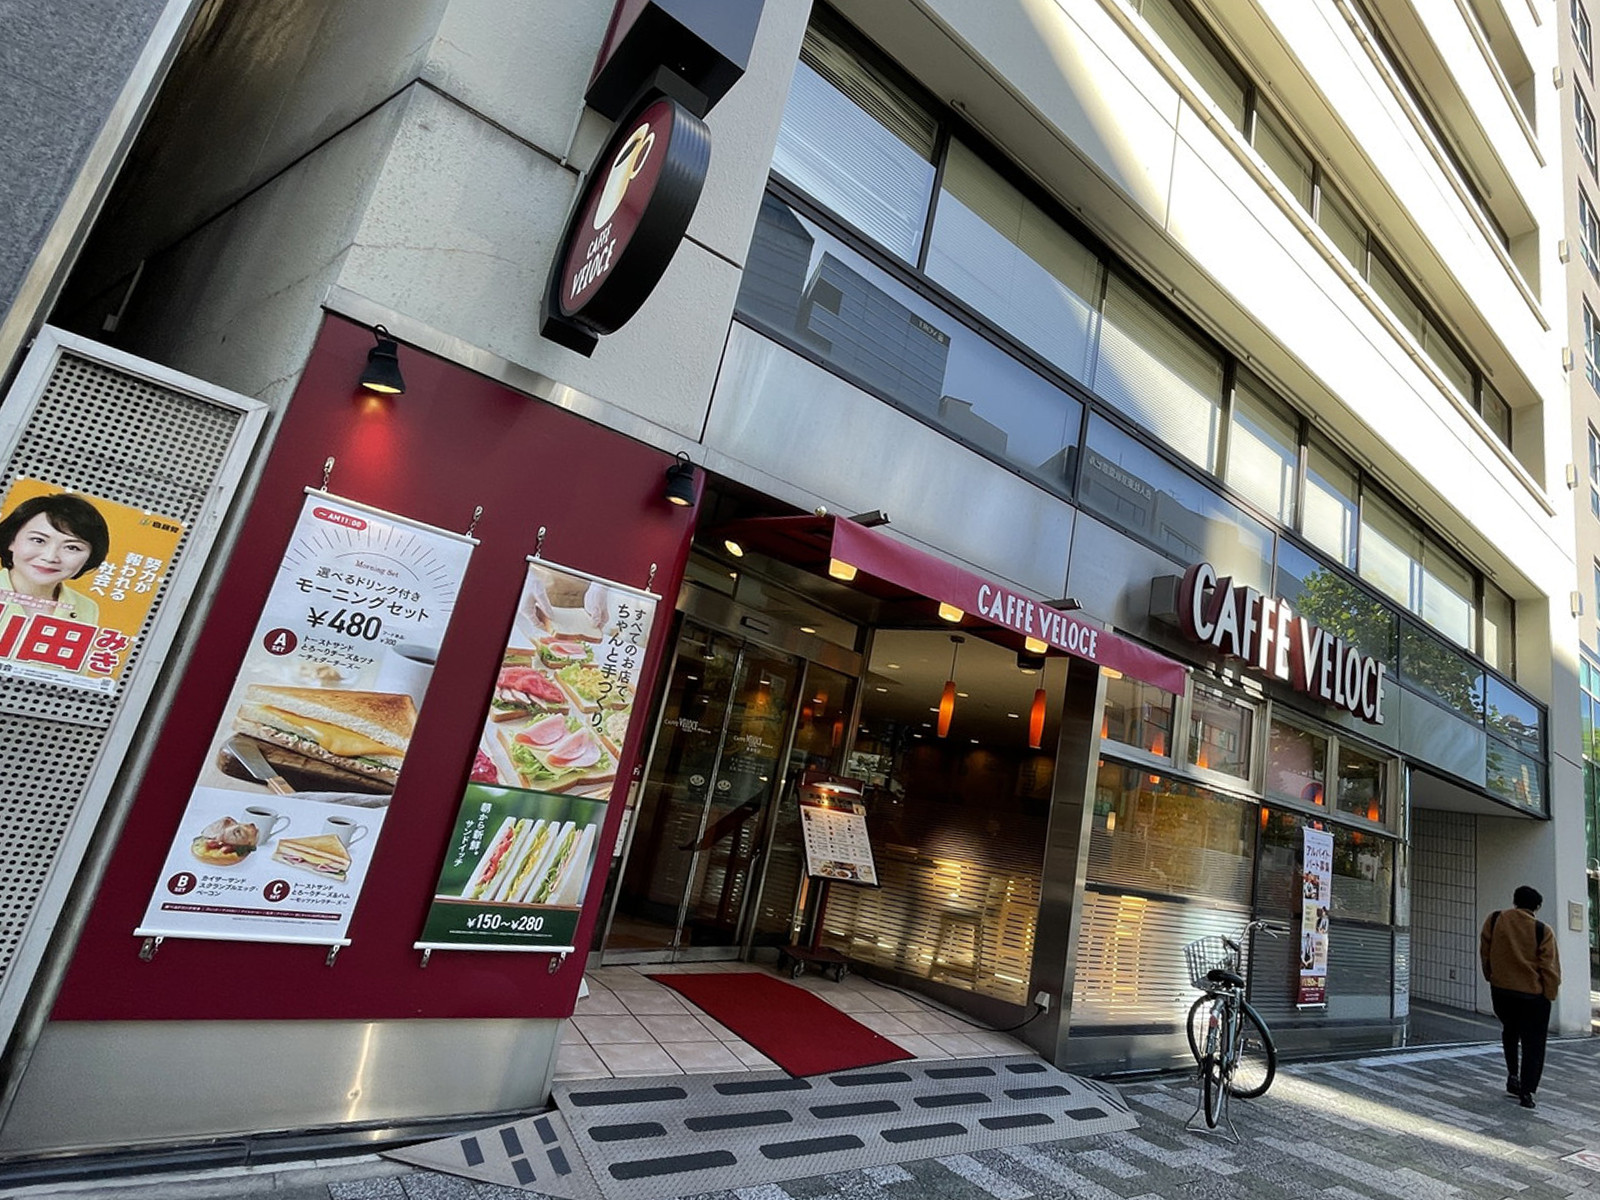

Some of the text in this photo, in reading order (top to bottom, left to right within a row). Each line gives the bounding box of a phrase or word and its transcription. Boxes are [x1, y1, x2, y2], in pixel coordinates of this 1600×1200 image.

[570, 238, 617, 300] VELOCE
[89, 560, 117, 597] 社会へ
[110, 552, 143, 601] 報われる
[134, 557, 163, 594] 努力が
[316, 565, 421, 602] 選べるドリンク付き
[355, 560, 386, 575] Morning
[296, 577, 430, 622] モーニングセット
[274, 632, 286, 647] A
[306, 606, 383, 641] ¥480
[1039, 608, 1097, 659] VELOCE
[88, 628, 129, 674] みき
[271, 645, 285, 653] SET
[304, 635, 355, 652] トーストサンド
[591, 603, 630, 733] ちゃんと手づくり。
[1299, 616, 1388, 725] VELOCE
[453, 820, 475, 867] サンドイッチ
[177, 875, 189, 887] B
[201, 875, 247, 884] カイザーサンド
[273, 883, 283, 895] C
